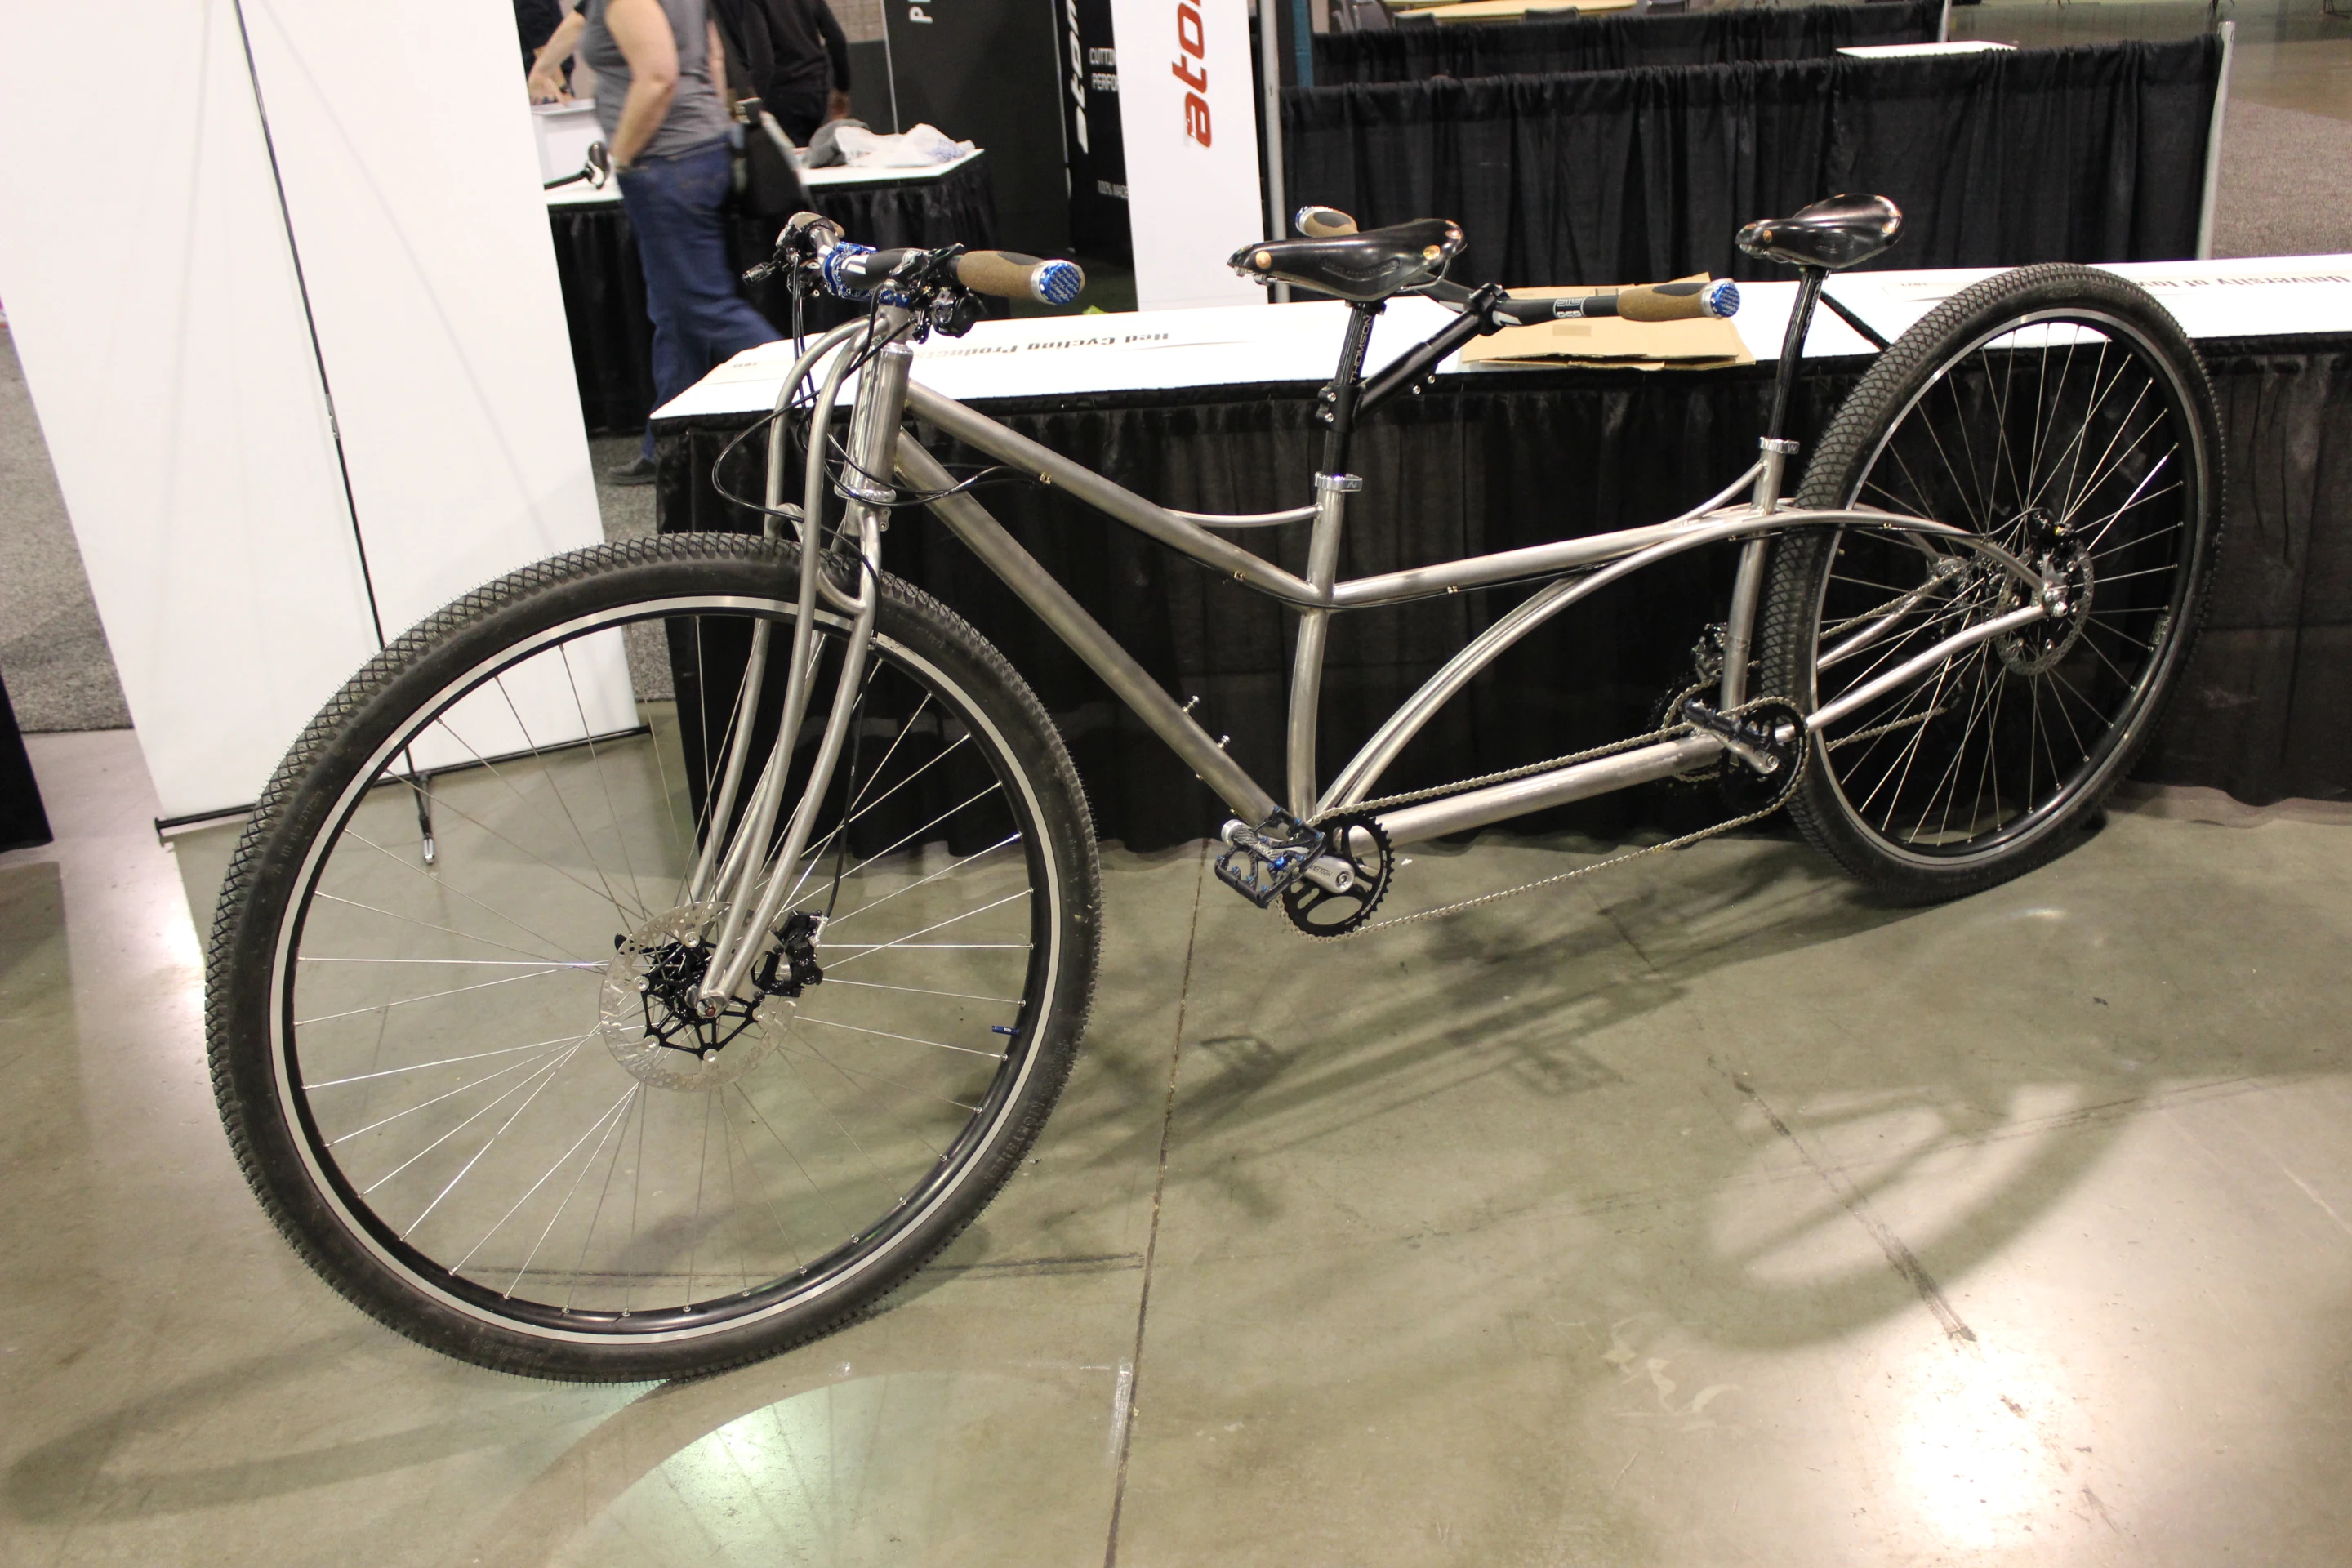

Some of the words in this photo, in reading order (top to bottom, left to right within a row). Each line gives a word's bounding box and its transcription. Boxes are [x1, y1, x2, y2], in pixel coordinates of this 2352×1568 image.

[1171, 0, 1212, 148] ato
[2183, 279, 2210, 287] of
[2216, 275, 2351, 286] University
[1027, 336, 1116, 350] Cycling
[1350, 314, 1372, 384] THOMSON
[913, 345, 1018, 360] Products
